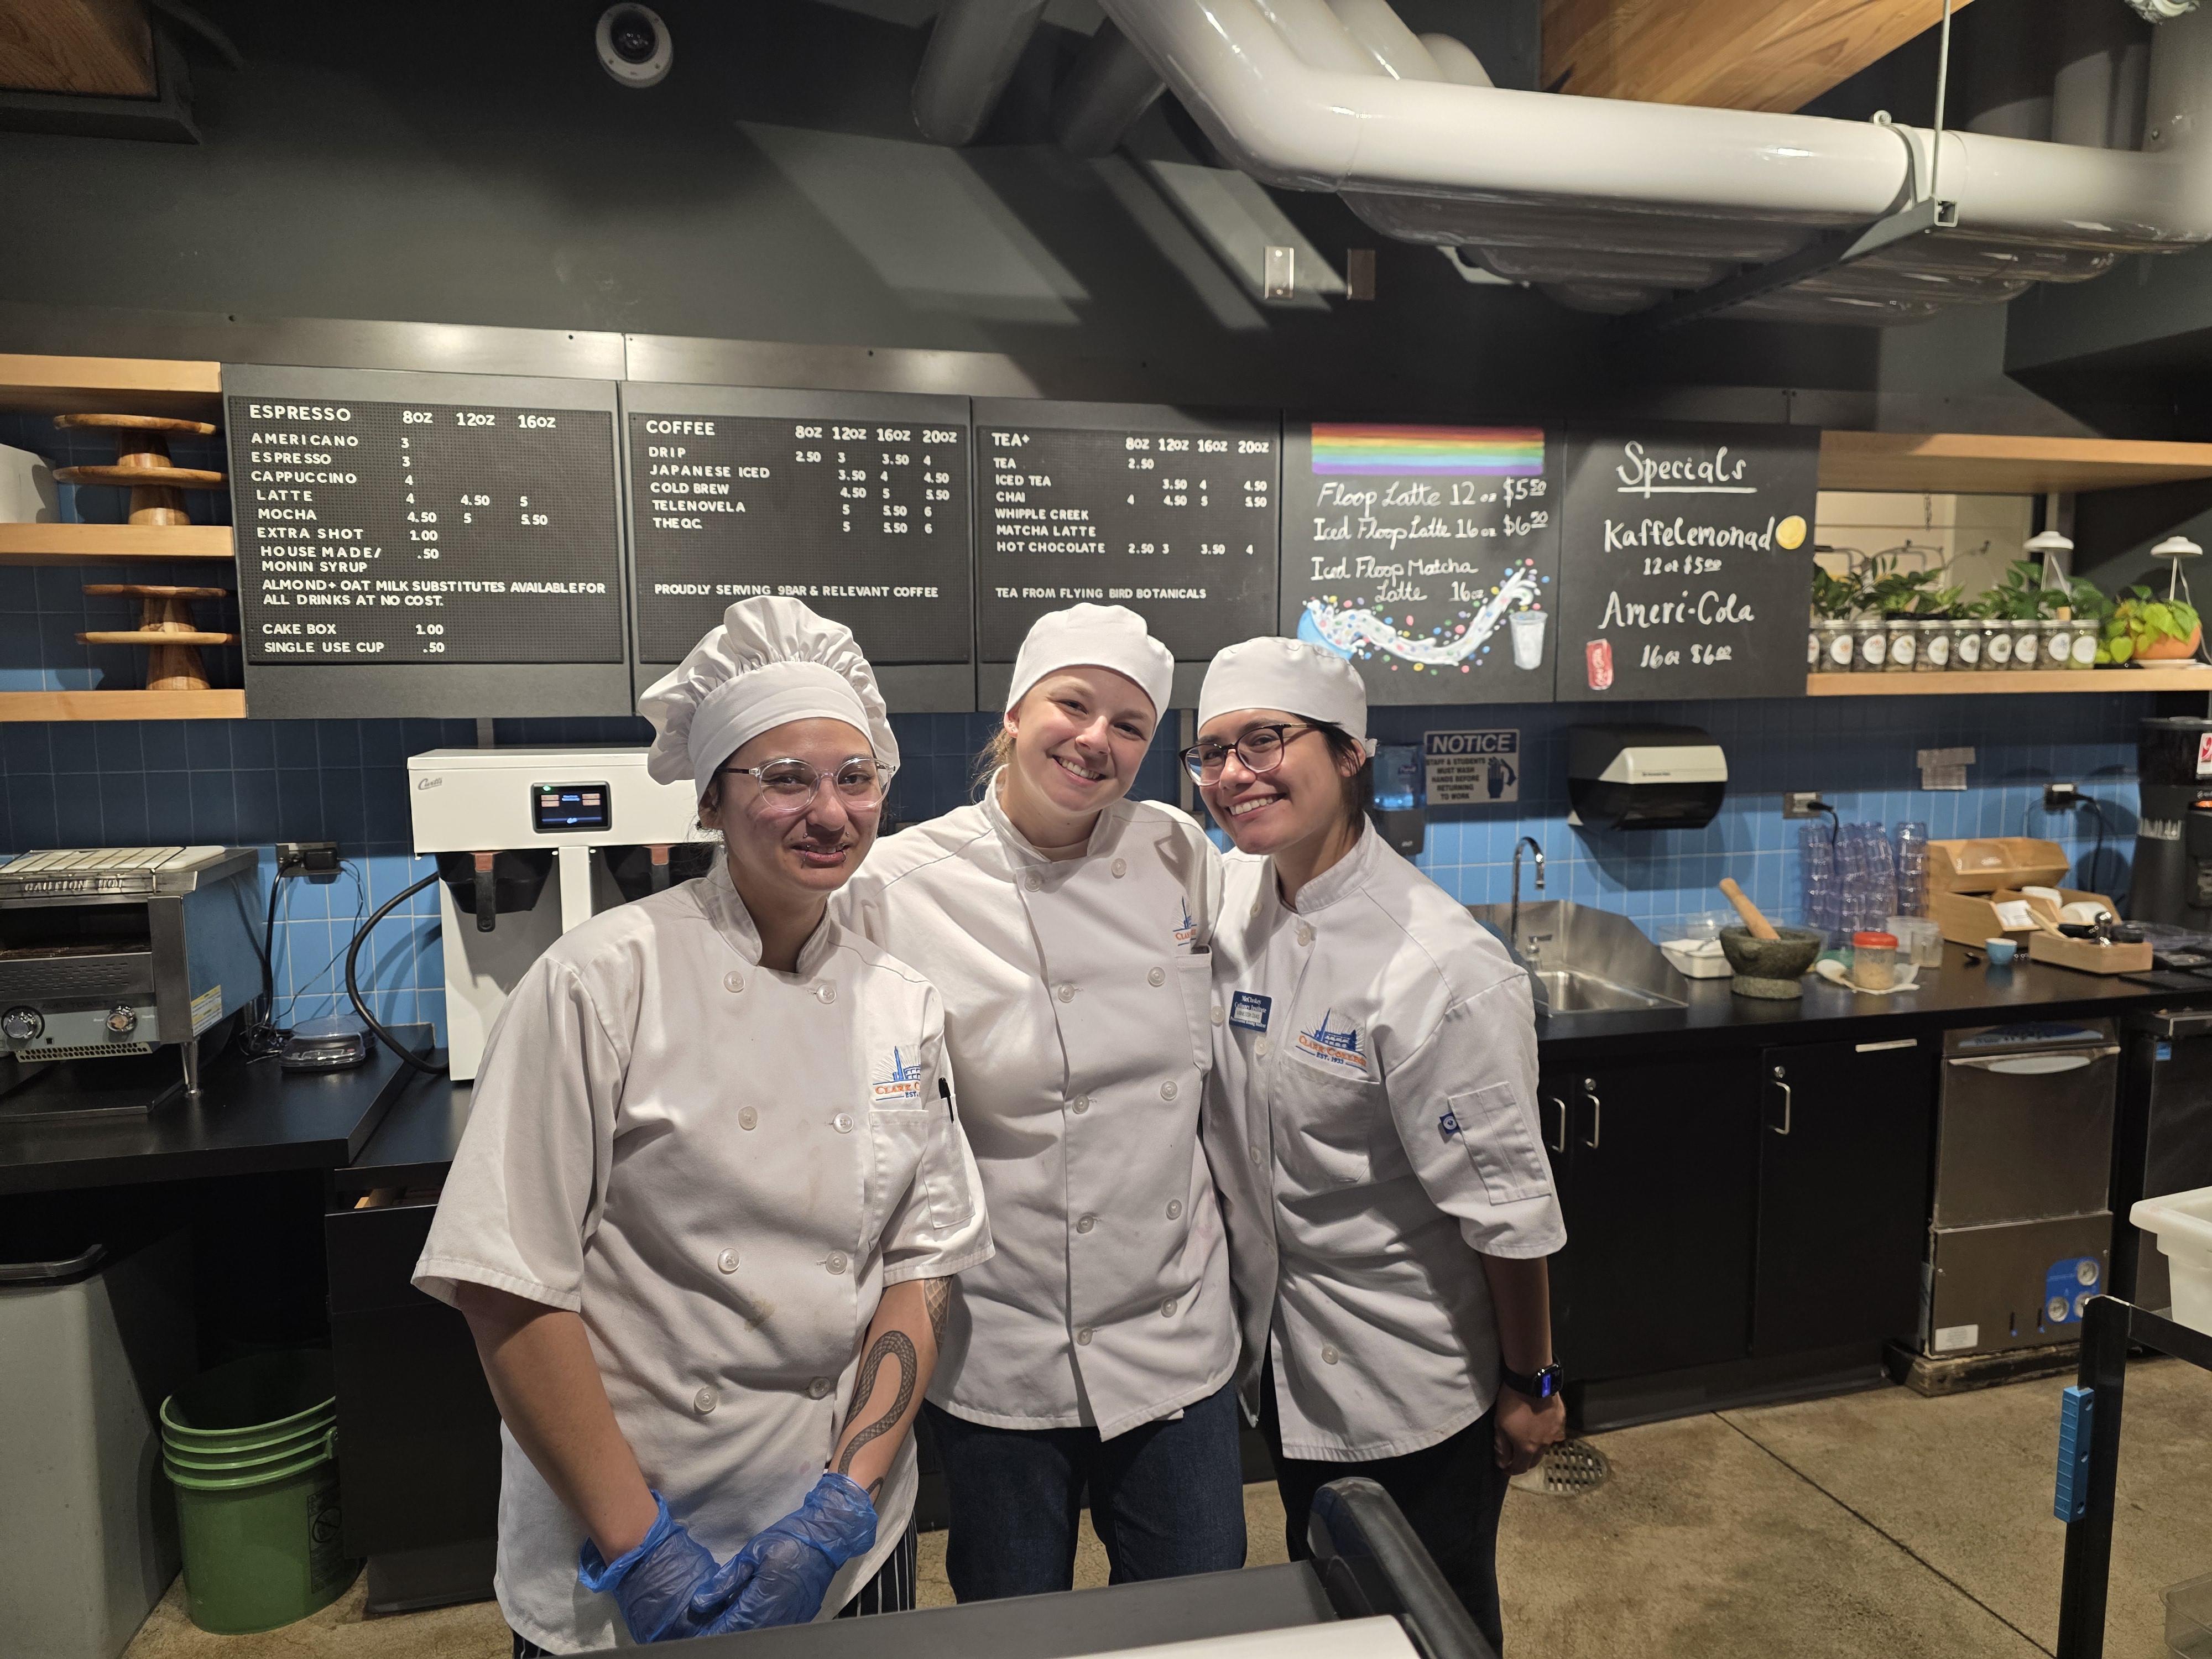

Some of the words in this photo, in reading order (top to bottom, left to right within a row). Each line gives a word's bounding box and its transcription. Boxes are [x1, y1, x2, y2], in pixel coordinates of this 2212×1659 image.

[249, 404, 351, 421] ESPRESSO
[646, 420, 715, 436] COFFEE
[251, 432, 359, 447] AMERICANO
[401, 437, 410, 448] 3
[991, 432, 1030, 447] TEA+
[251, 451, 332, 465] ESPRESSO
[402, 456, 411, 467] 3
[648, 446, 686, 458] DRIP
[838, 452, 846, 463] 3
[882, 453, 910, 466] 3.50
[923, 455, 931, 466] 4
[993, 457, 1016, 469] TEA
[1128, 458, 1154, 469] 2.50
[251, 470, 357, 484] CAPPUCCINO
[404, 474, 414, 486] 4
[649, 464, 731, 477] JAPANESE
[738, 467, 770, 478] ICED
[838, 469, 866, 481] 3.50
[880, 471, 888, 482] 4
[924, 472, 950, 484] 4.50
[1616, 441, 1746, 499] Specials
[650, 482, 690, 494] COLD
[693, 483, 729, 495] BREW
[840, 487, 867, 498] 4.50
[883, 488, 890, 499] 5
[926, 489, 950, 500] 5.50
[995, 474, 1024, 486] ICED
[1028, 475, 1052, 487] TEA
[1162, 478, 1187, 490] 3.50
[1199, 479, 1207, 490] 4
[1244, 480, 1267, 492] 4.50
[256, 489, 313, 502] LATTE
[405, 493, 415, 504] 4
[460, 494, 491, 506] 4.50
[520, 495, 528, 507] 5
[995, 491, 1025, 503] CHAI
[1127, 494, 1135, 505] 4
[1163, 495, 1187, 506] 4.50
[1201, 495, 1208, 507] 5
[1245, 496, 1267, 508] 5.50
[1317, 482, 1377, 517] Floop
[1382, 481, 1441, 507] Latte
[1449, 481, 1476, 505] 12
[651, 499, 745, 513] TELENOVELA
[842, 504, 850, 515] 5
[883, 505, 907, 517] 5.50
[924, 506, 932, 517] 6
[994, 508, 1046, 520] WHIPPLE
[1050, 509, 1089, 520] CREEK
[258, 508, 317, 520] MOCHA
[407, 511, 437, 523] 4.50
[463, 513, 472, 524] 5
[521, 514, 548, 525] 5.50
[257, 526, 310, 539] EXTRA
[317, 528, 364, 540] SHOT
[409, 529, 438, 541] 1.00
[843, 521, 851, 532] 5
[883, 522, 908, 534] 5.50
[924, 523, 933, 534] 6
[997, 524, 1049, 536] MATCHA
[1053, 525, 1096, 538] LATTE
[1313, 515, 1352, 540] Iced
[1358, 517, 1407, 550] Floop
[1408, 515, 1451, 539] Latte
[1455, 519, 1478, 538] 16
[1604, 516, 1775, 552] Kaffelemonad
[260, 545, 317, 557] HOUSE
[322, 546, 382, 559] MADE/
[417, 548, 439, 559] .50
[997, 541, 1025, 552] HOT
[1028, 541, 1105, 554] CHOCOLATE
[1128, 543, 1154, 554] 2.50
[1162, 543, 1170, 554] 3
[1201, 544, 1225, 555] 3.50
[1245, 544, 1253, 555] 4
[262, 560, 314, 572] MONIN
[320, 561, 368, 573] SYRUP
[1311, 557, 1350, 581] Iced
[1355, 556, 1404, 587] Floop
[1408, 558, 1479, 577] Matcha
[262, 579, 337, 591] ALMOND+
[340, 580, 371, 591] OAT
[375, 580, 409, 592] MILK
[412, 581, 506, 593] SUBSTITUTES
[510, 582, 578, 593] AVAILABLE
[578, 582, 606, 594] FOR
[654, 583, 711, 595] PROUDLY
[716, 585, 771, 595] SERVING
[778, 585, 807, 596] 9BAR
[809, 586, 818, 596] &
[822, 586, 890, 597] RELEVANT
[893, 587, 938, 598] COFFEE
[995, 587, 1019, 598] TEA
[1022, 588, 1056, 598] FROM
[1060, 588, 1103, 598] FLYING
[1109, 588, 1133, 599] BIRD
[1136, 588, 1207, 599] BOTANICALS
[1375, 580, 1428, 603] Latte
[263, 594, 290, 605] ALL
[296, 594, 351, 606] DRINKS
[356, 594, 376, 606] AT
[380, 594, 400, 606] NO
[404, 595, 444, 606] COST.
[1598, 591, 1754, 629] Ameri-Cola
[262, 623, 302, 634] CAKE
[306, 623, 337, 635] BOX
[415, 624, 444, 635] 1.00
[264, 641, 315, 653] SINGLE
[322, 641, 351, 653] USE
[356, 641, 384, 653] CUP
[422, 641, 445, 653] .50
[1433, 734, 1511, 753] NOTICE
[1316, 1052, 1329, 1061] EST.
[875, 1084, 911, 1094] CLARK
